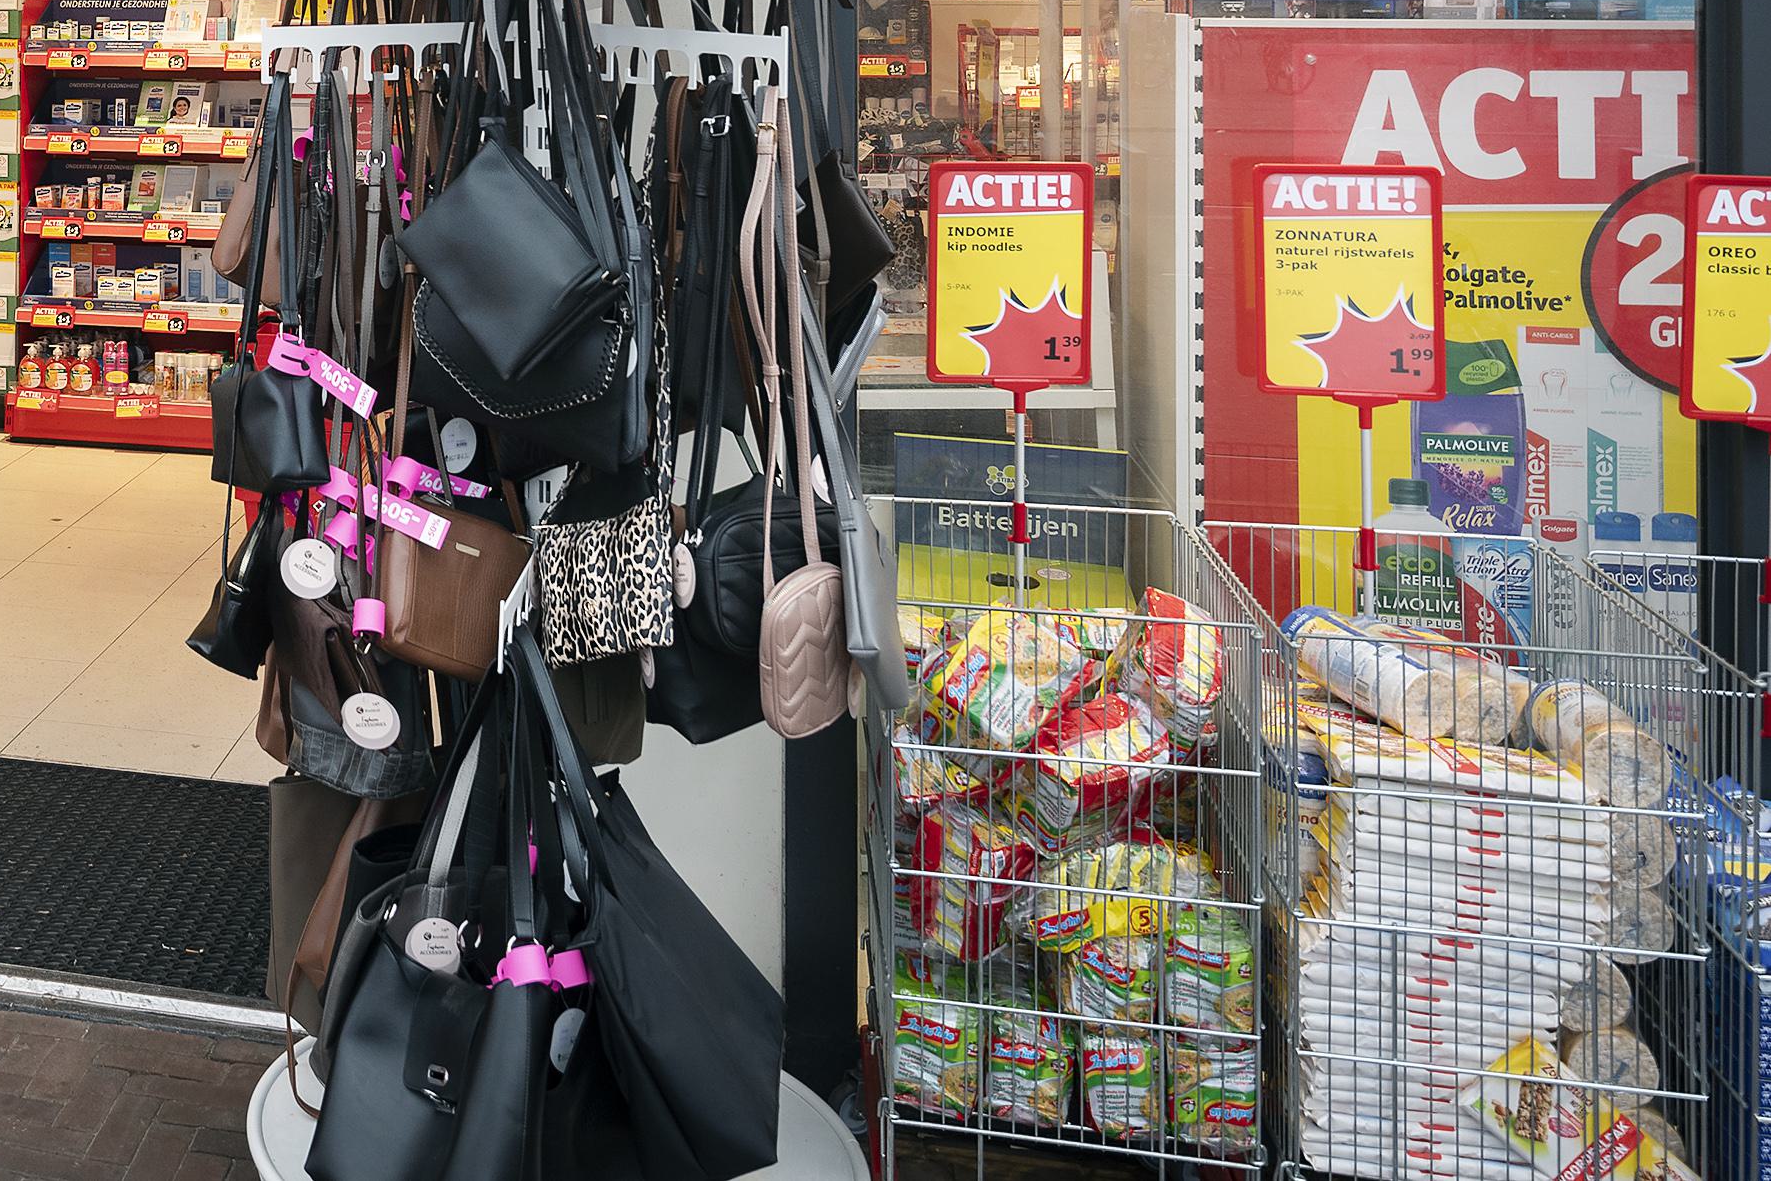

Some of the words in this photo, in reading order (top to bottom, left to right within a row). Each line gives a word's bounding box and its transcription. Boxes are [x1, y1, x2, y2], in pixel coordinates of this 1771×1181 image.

[59, 0, 112, 9] ONDERSTEUN
[112, 0, 121, 8] JE
[122, 0, 168, 9] GEZONDHEI
[889, 64, 905, 74] 1+1
[945, 174, 1072, 208] ACTIE!
[1271, 176, 1417, 213] ACTIE!
[947, 227, 1014, 237] INDOMIE
[1275, 229, 1378, 242] ZONNATURA
[947, 242, 967, 253] kip
[972, 242, 1023, 252] noodles
[1276, 246, 1329, 256] naturel
[1334, 247, 1414, 259] rijstwafels
[1708, 246, 1757, 259] OREO
[1276, 259, 1318, 271] 3-pak
[1707, 263, 1761, 275] classic
[1276, 289, 1304, 297] 3-PAK
[1707, 309, 1726, 318] 176
[1728, 309, 1736, 318] G
[1531, 331, 1574, 340] ANTI-CARIES
[1043, 336, 1081, 362] 1.39
[1390, 348, 1433, 376] 1.99
[1426, 438, 1509, 453] PALMOLIVE
[1528, 443, 1546, 519] elmex
[1590, 443, 1614, 517] elmex
[1442, 504, 1496, 531] Relax
[1542, 524, 1576, 533] Colgate
[1385, 554, 1436, 572] eco
[1465, 555, 1499, 566] Triple
[1457, 563, 1497, 575] Action
[1400, 574, 1455, 589] REFILL
[1138, 909, 1151, 927] 5
